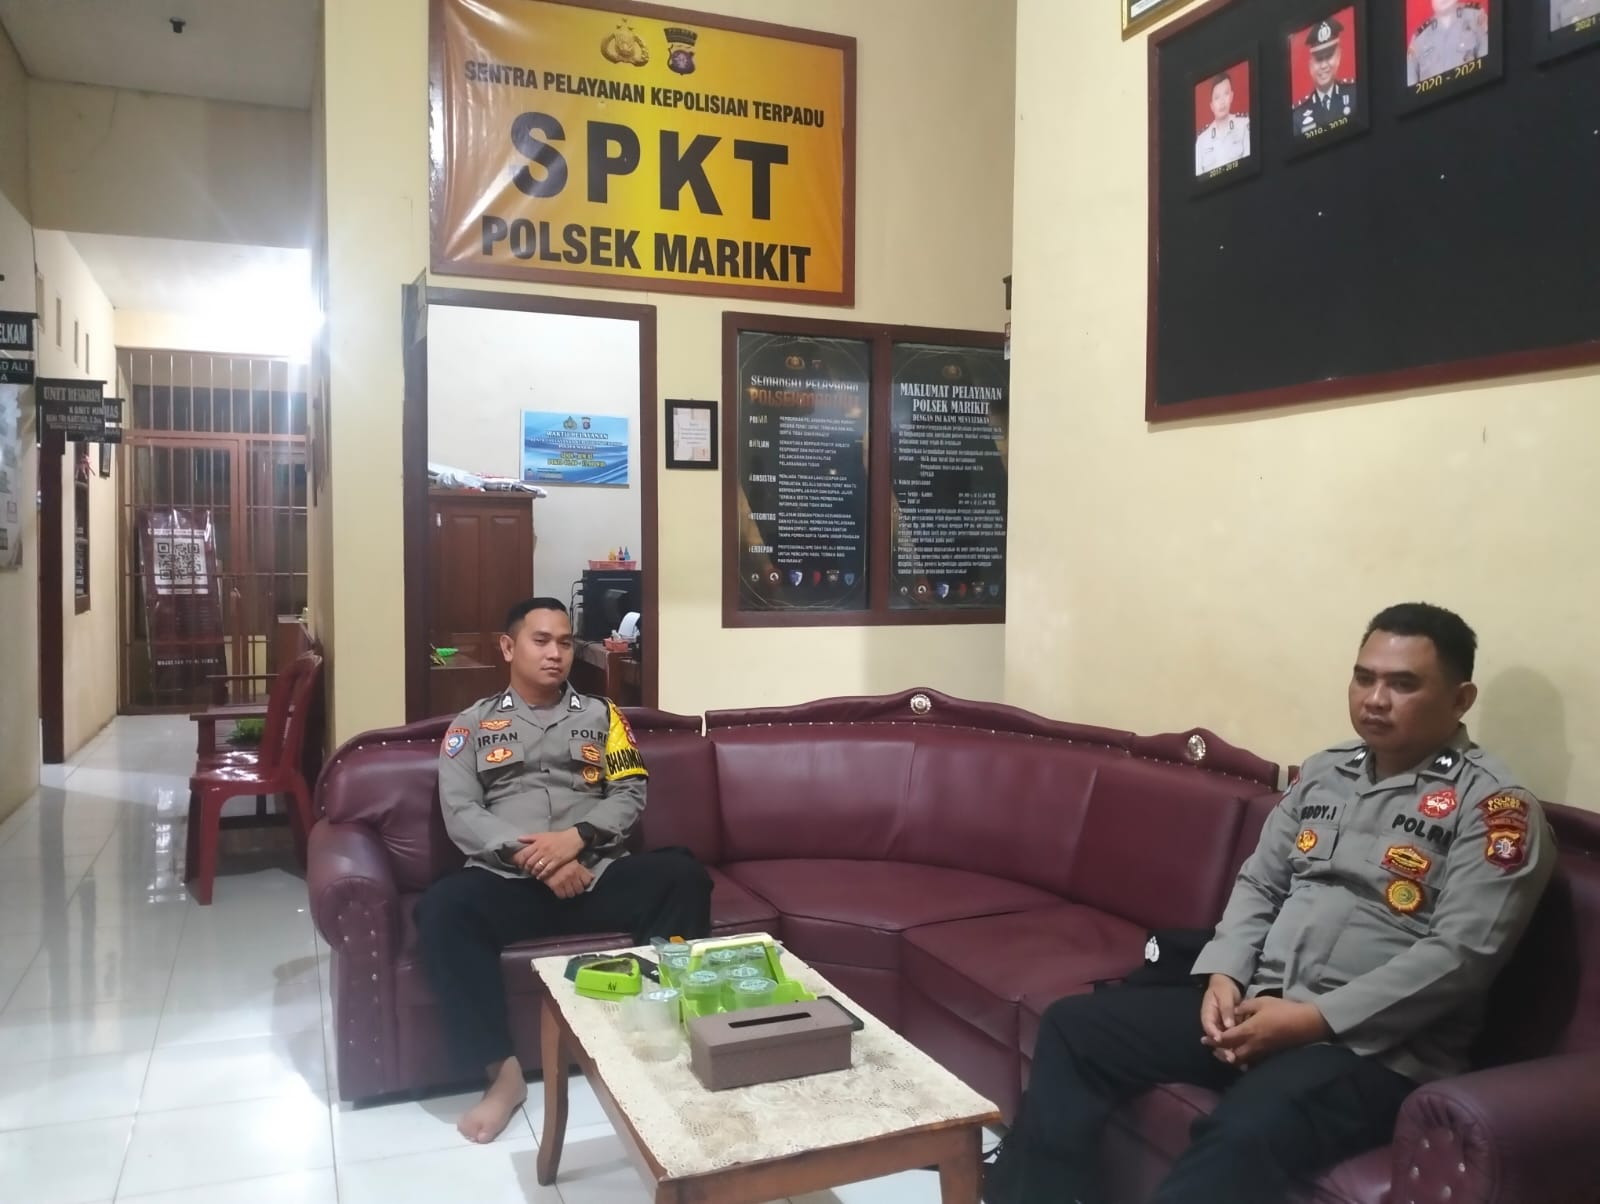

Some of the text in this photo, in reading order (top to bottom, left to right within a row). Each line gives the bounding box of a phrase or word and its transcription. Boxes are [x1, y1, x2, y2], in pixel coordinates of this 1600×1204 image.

[1415, 75, 1443, 94] 2020
[1454, 59, 1482, 80] 2021
[464, 60, 825, 128] SENTRA PELAYANAN KEPOLISIAN TERPADU
[510, 111, 789, 220] SPKT
[481, 215, 811, 283] POLSEK MARIKIT
[900, 382, 1002, 400] MAKLUMAT PELAYANAN
[913, 398, 990, 415] POLSEK MARIKIT
[478, 731, 518, 748] IRFAN
[571, 729, 607, 744] POLRI
